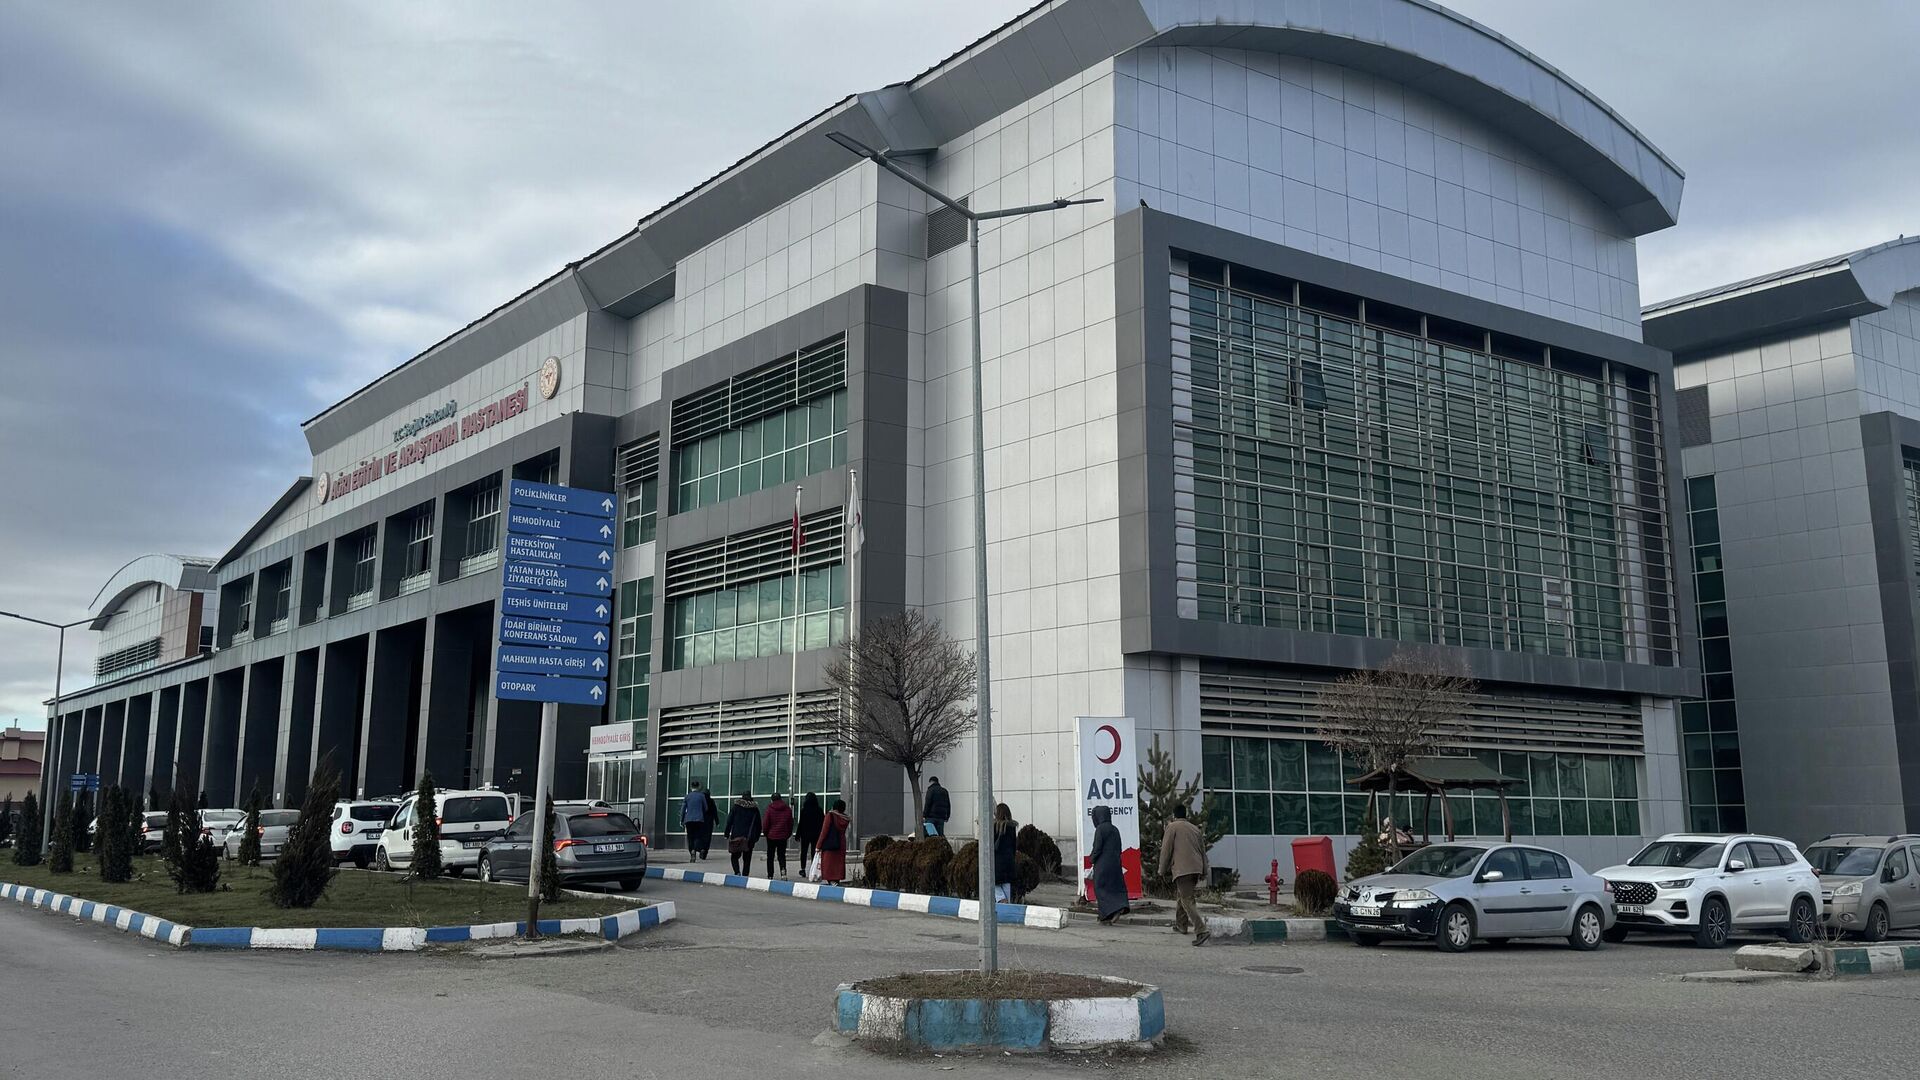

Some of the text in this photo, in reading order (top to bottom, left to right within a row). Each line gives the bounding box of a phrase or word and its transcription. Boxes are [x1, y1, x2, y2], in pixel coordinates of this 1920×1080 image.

[351, 456, 383, 492] EĞİTİM
[383, 451, 398, 475] VE
[398, 422, 459, 469] ARAŞTIRMA
[460, 381, 529, 440] HASTANESİ
[514, 487, 567, 502] POLİKLİNİKLER
[512, 515, 561, 529] HEMODİYALİZ
[511, 538, 555, 550] ENFEKSİYON
[510, 547, 561, 560] HASTALIKLARI
[508, 565, 559, 578] YATAN HASTA
[508, 573, 544, 586] ZİYARETÇİ
[507, 597, 569, 611] TEŞHİS ÜNİTELERİ
[527, 621, 561, 633] BİRİMLER
[504, 630, 577, 644] KONFERANS SALONU
[502, 654, 586, 669] MAHKUM HASTA GİRİŞİ
[501, 681, 536, 692] OTOPARK
[1087, 772, 1133, 800] ACİL
[1087, 806, 1133, 816] EGENCY
